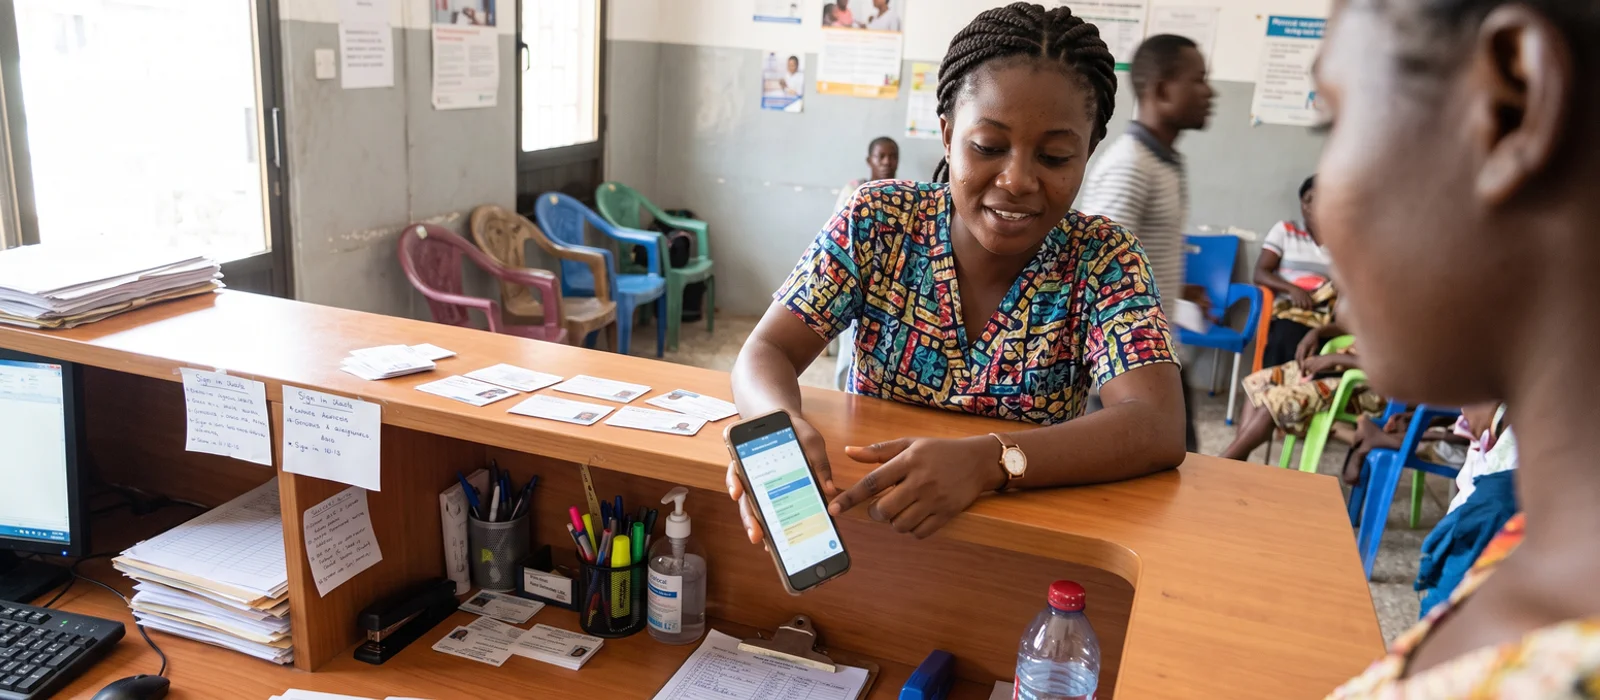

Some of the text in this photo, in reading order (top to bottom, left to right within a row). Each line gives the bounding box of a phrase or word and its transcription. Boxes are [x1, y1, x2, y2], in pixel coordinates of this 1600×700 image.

[196, 373, 211, 386] Sign
[298, 391, 315, 405] Sign
[320, 396, 328, 404] in
